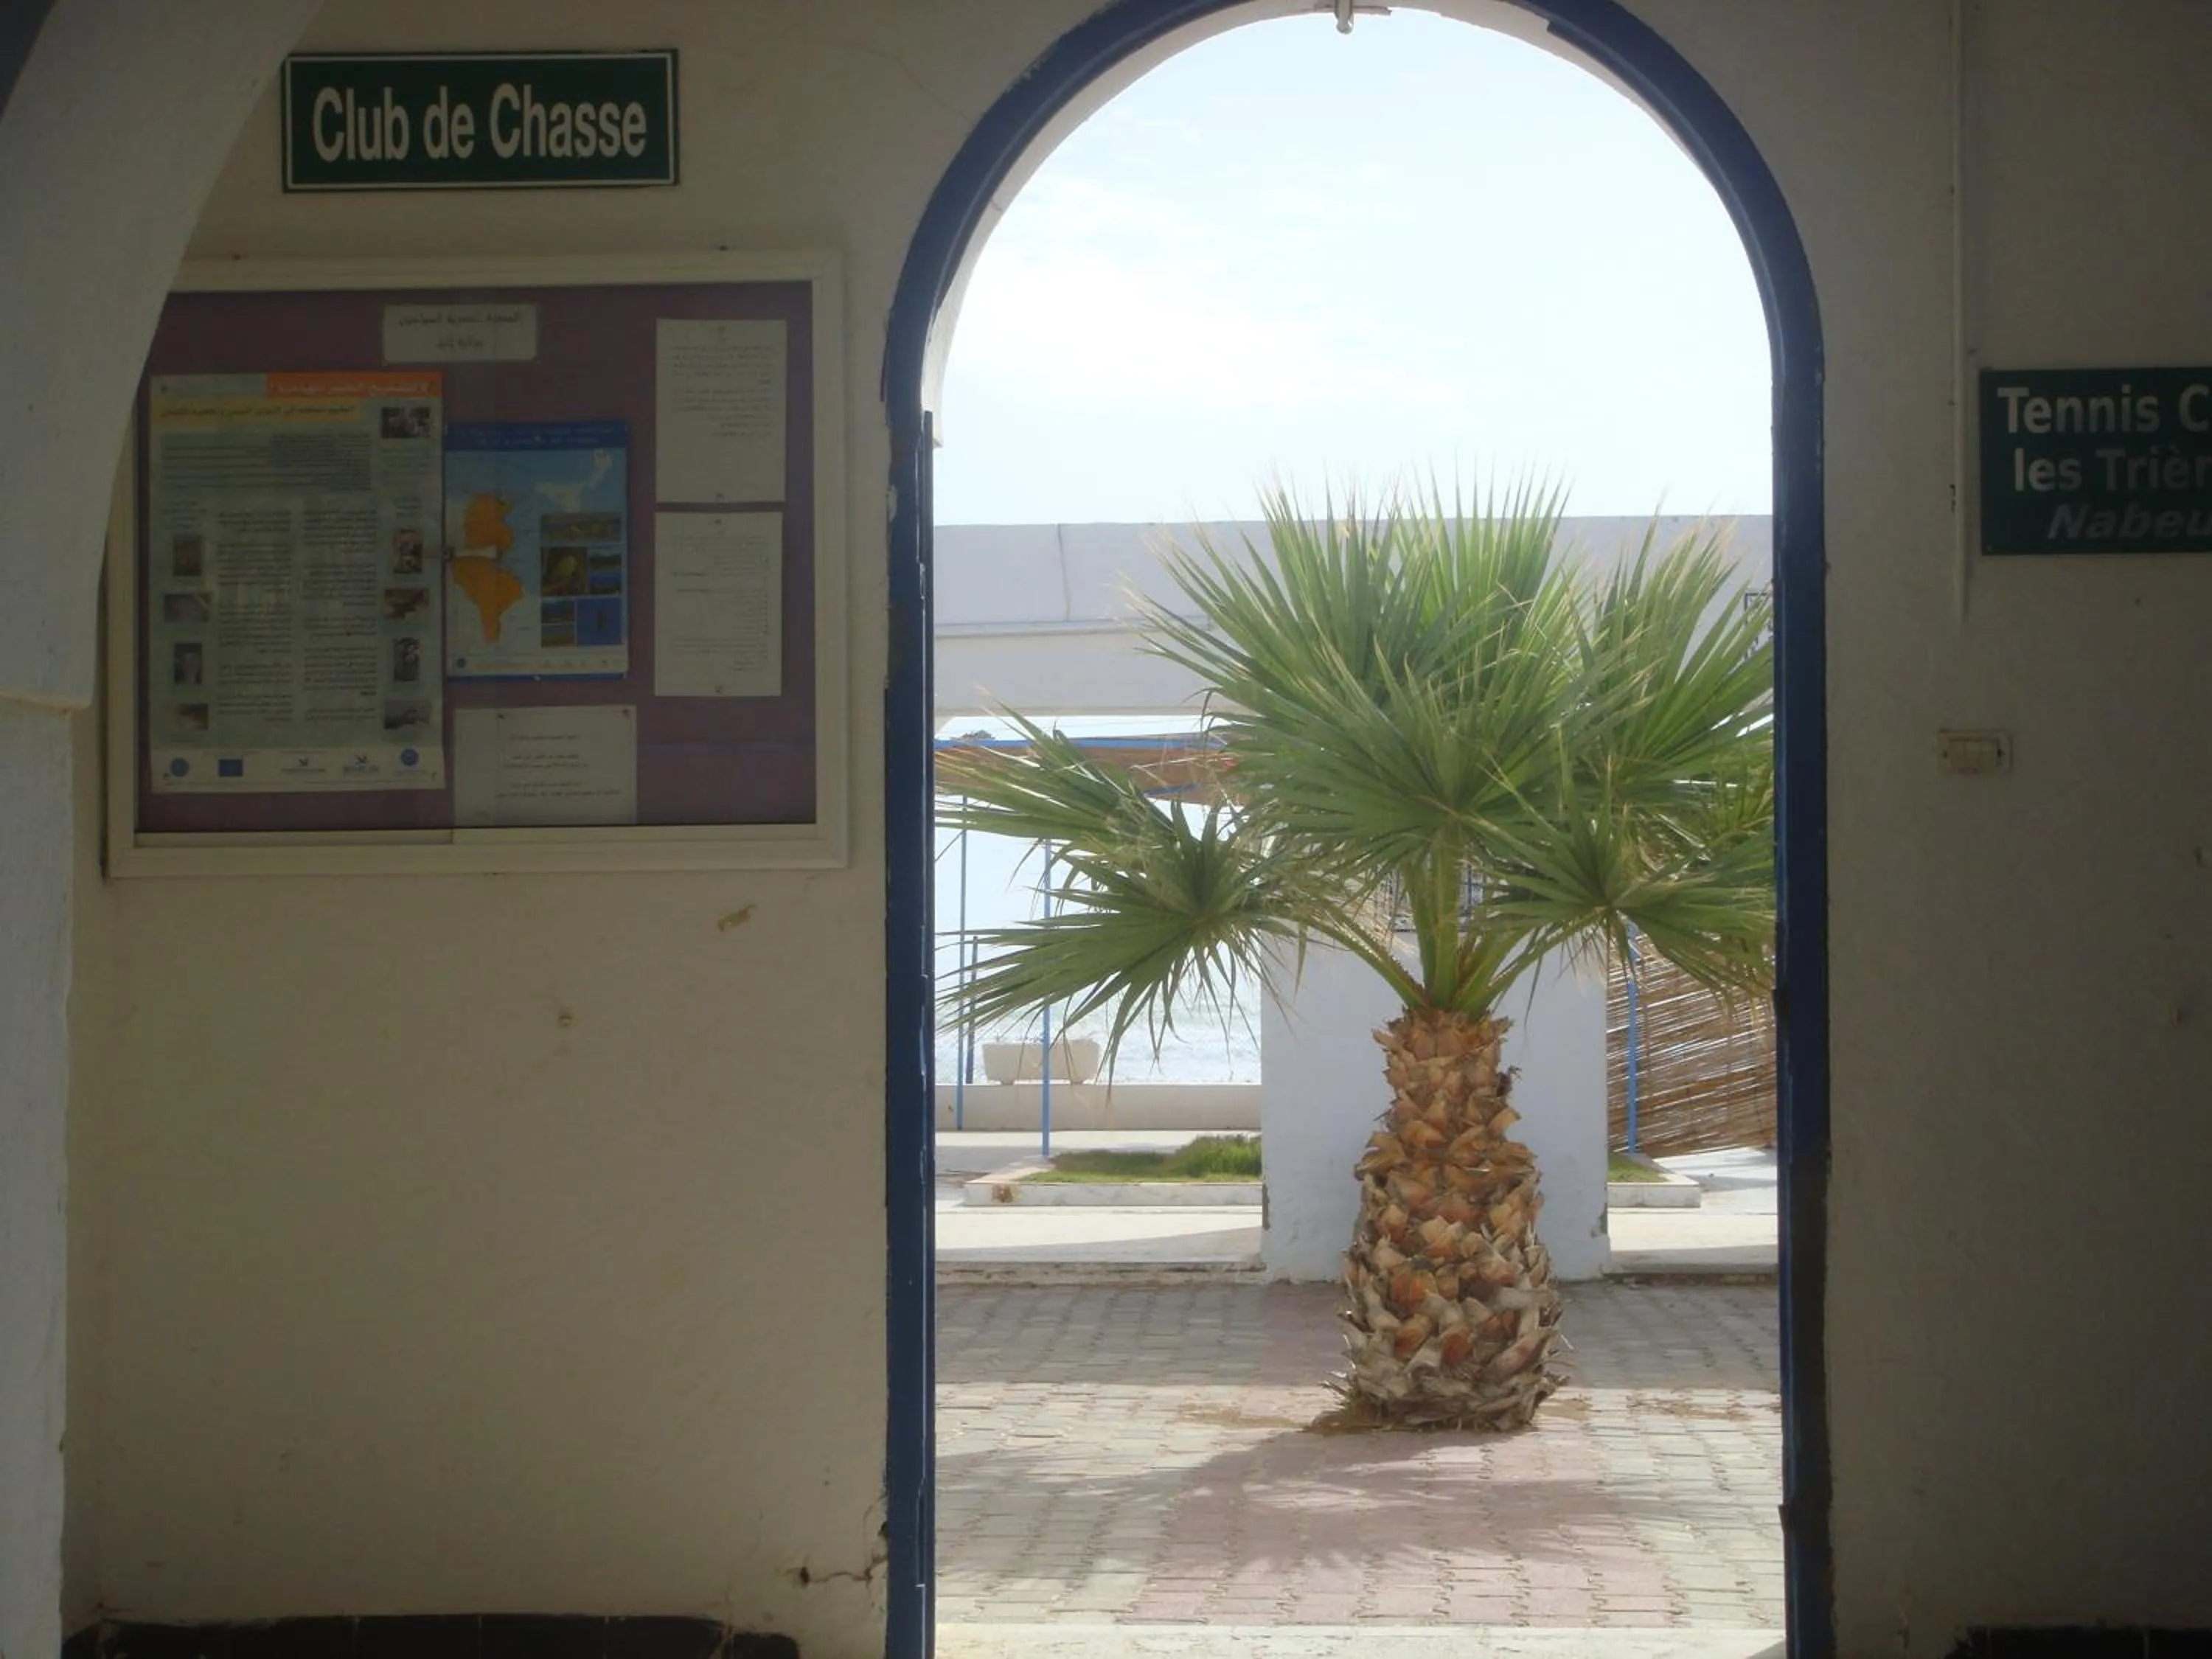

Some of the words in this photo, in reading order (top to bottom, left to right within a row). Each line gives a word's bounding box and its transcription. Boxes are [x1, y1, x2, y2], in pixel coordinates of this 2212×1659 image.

[313, 86, 409, 163] Club
[425, 85, 476, 159] de
[490, 82, 647, 159] Chasse
[1997, 383, 2160, 434] Tennis
[2014, 447, 2084, 493] les
[2046, 500, 2212, 540] Nabeu
